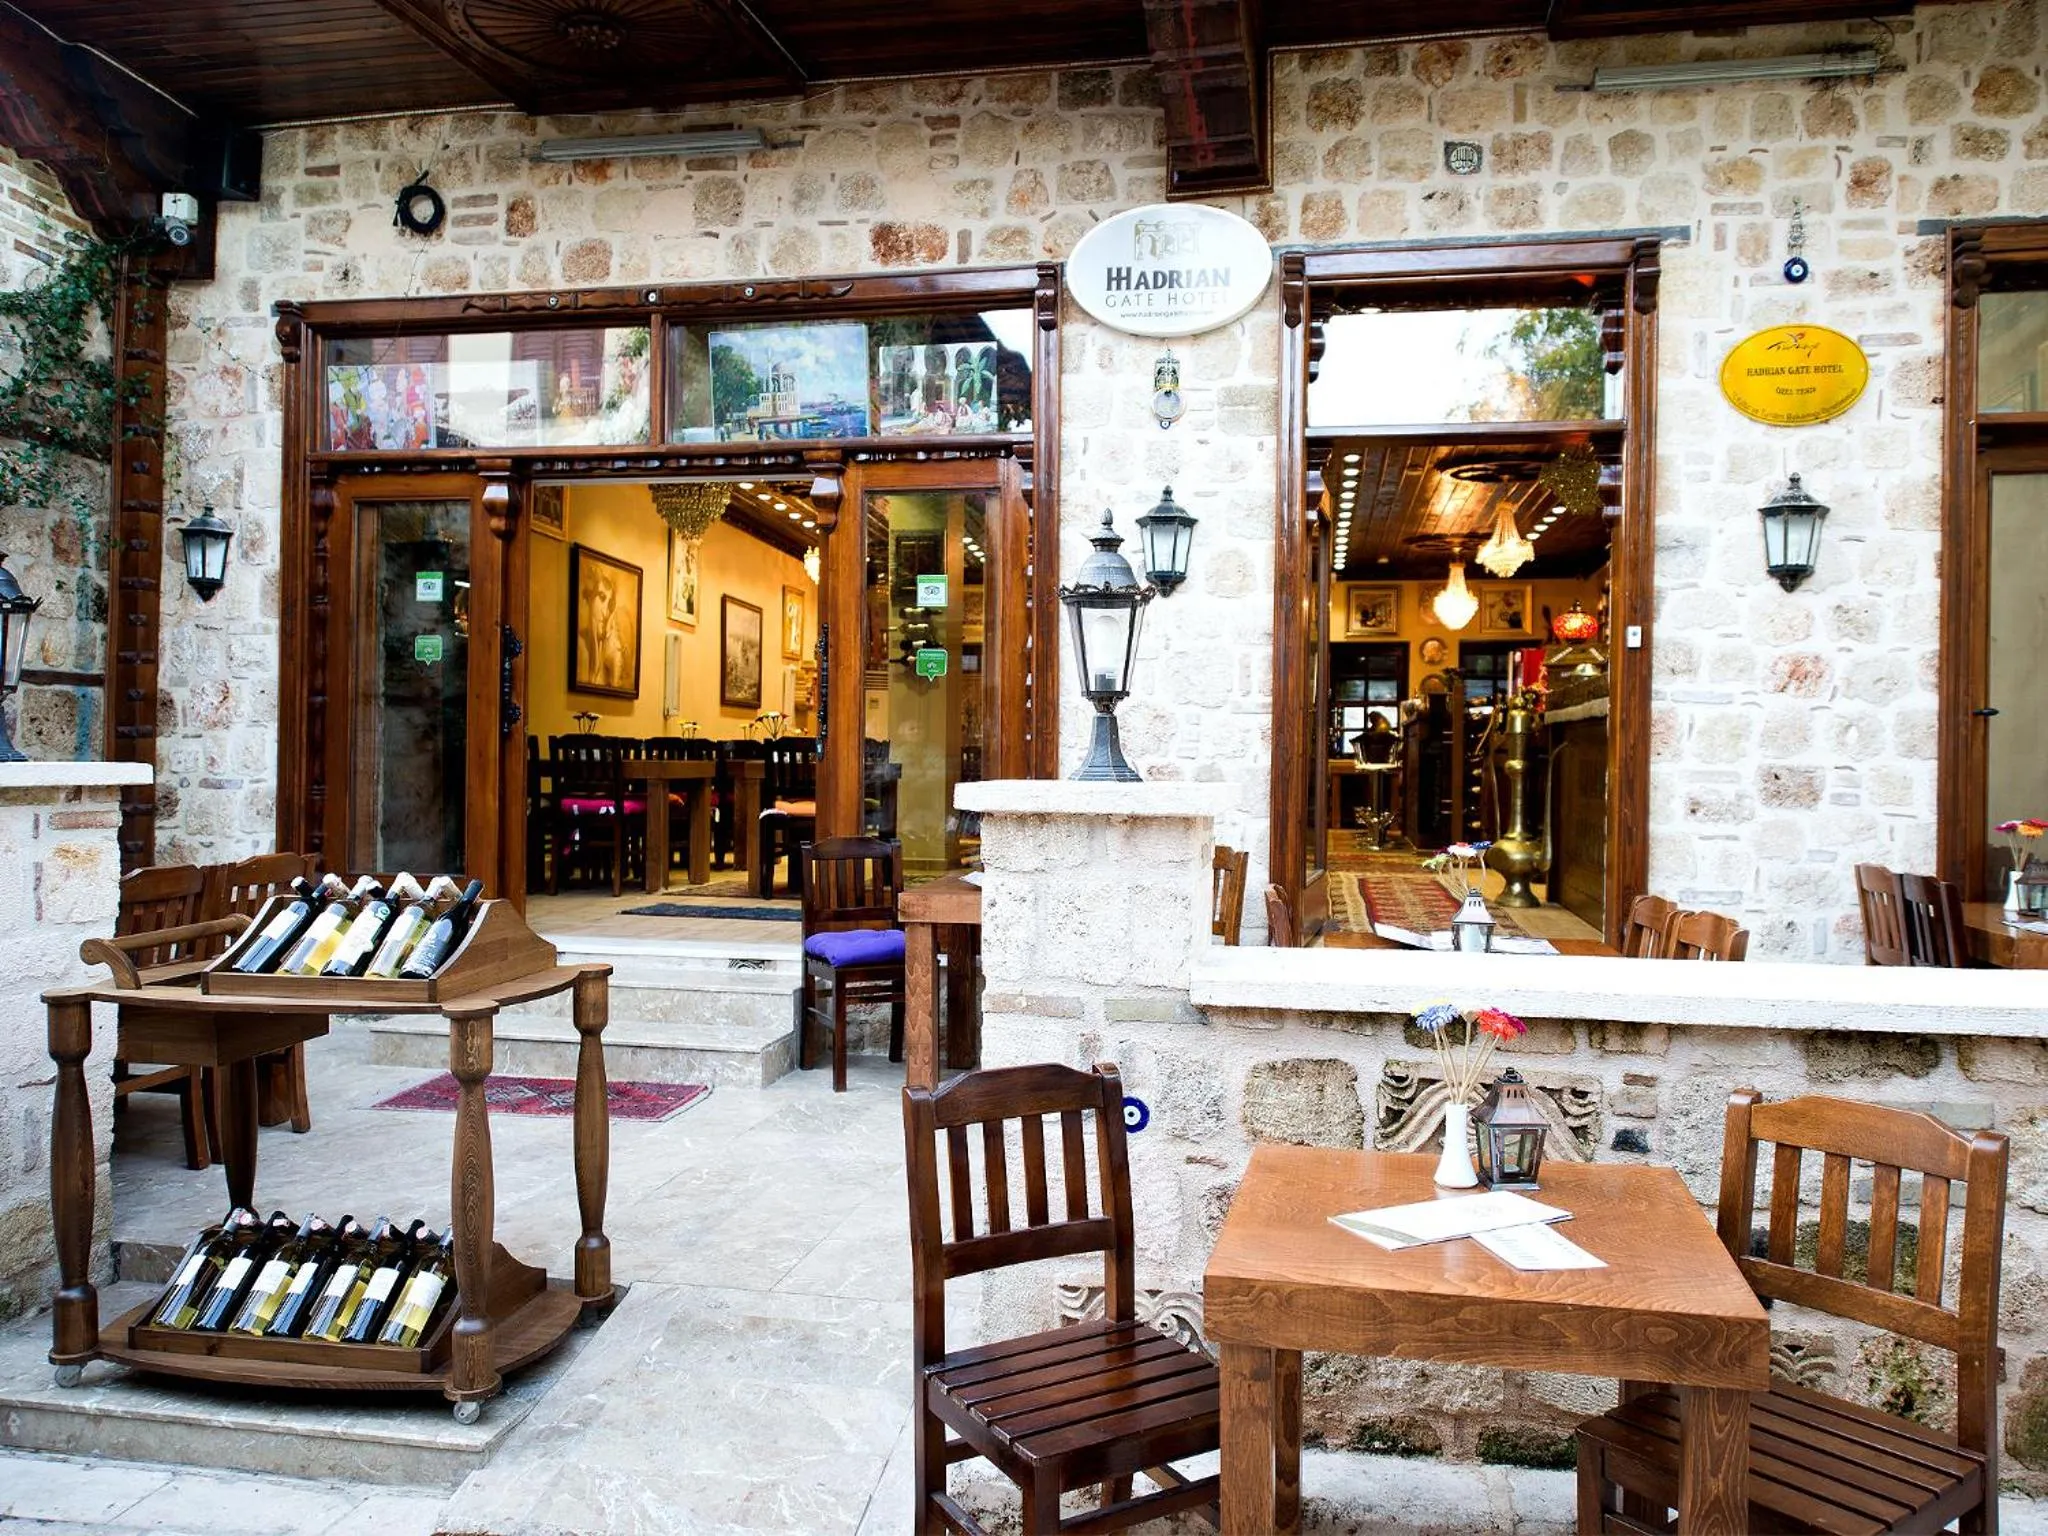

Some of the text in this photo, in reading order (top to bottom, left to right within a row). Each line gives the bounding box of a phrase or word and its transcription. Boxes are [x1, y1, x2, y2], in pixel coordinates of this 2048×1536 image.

[1105, 291, 1228, 308] GATE HOTEL
[1747, 364, 1844, 377] HADRIAN GATE HOTEL
